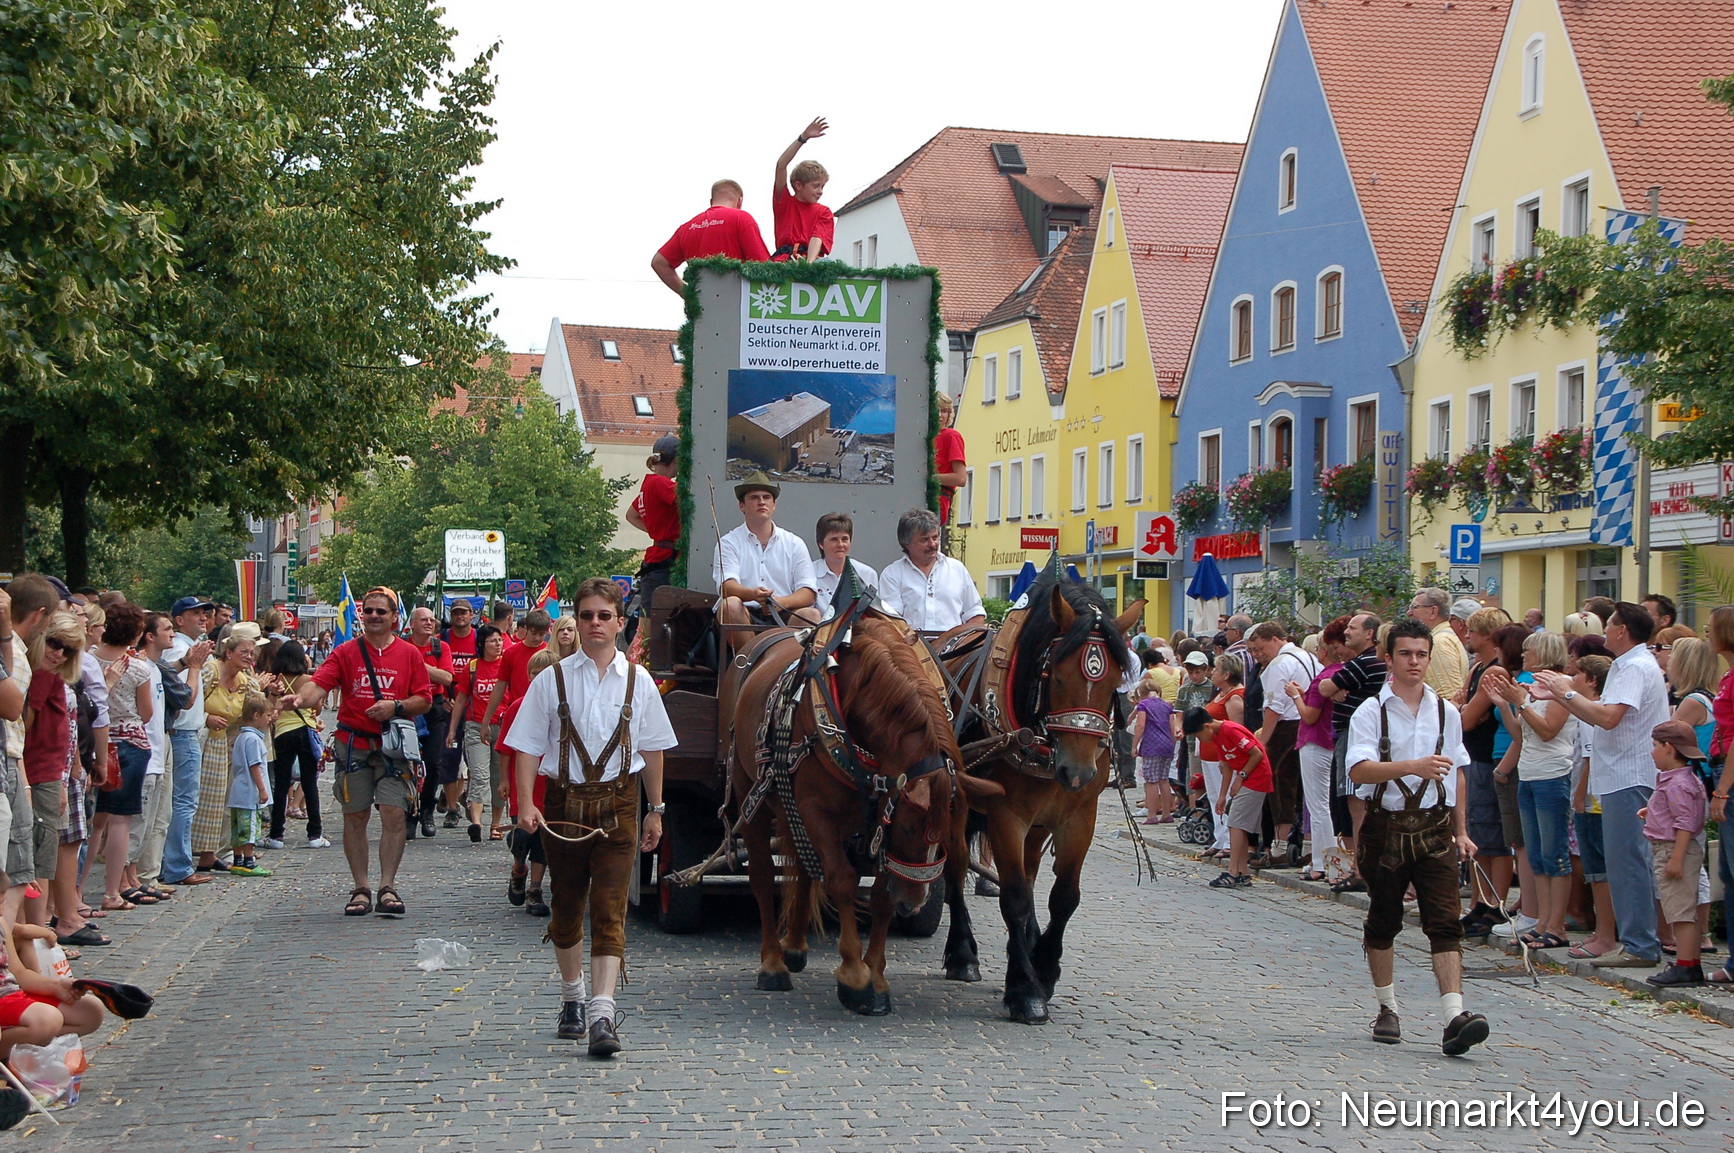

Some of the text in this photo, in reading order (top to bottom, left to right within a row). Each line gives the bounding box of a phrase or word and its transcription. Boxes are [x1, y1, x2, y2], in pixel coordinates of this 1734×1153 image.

[791, 282, 878, 317] DAV
[748, 322, 881, 339] Deutscher Alpenverein
[748, 337, 881, 352] Sektion Neumarkt i.d. OPf.
[748, 356, 880, 371] www.olpererhuette.de
[995, 428, 1021, 454] HOTEL
[1383, 452, 1399, 531] WITTL
[1722, 464, 1733, 538] KIO
[450, 531, 485, 541] Verband
[1087, 524, 1094, 551] P
[1457, 529, 1475, 560] P
[449, 544, 502, 555] Christlicher
[990, 548, 1028, 566] Restaurant
[508, 599, 524, 607] TAXI
[478, 683, 497, 693] DA
